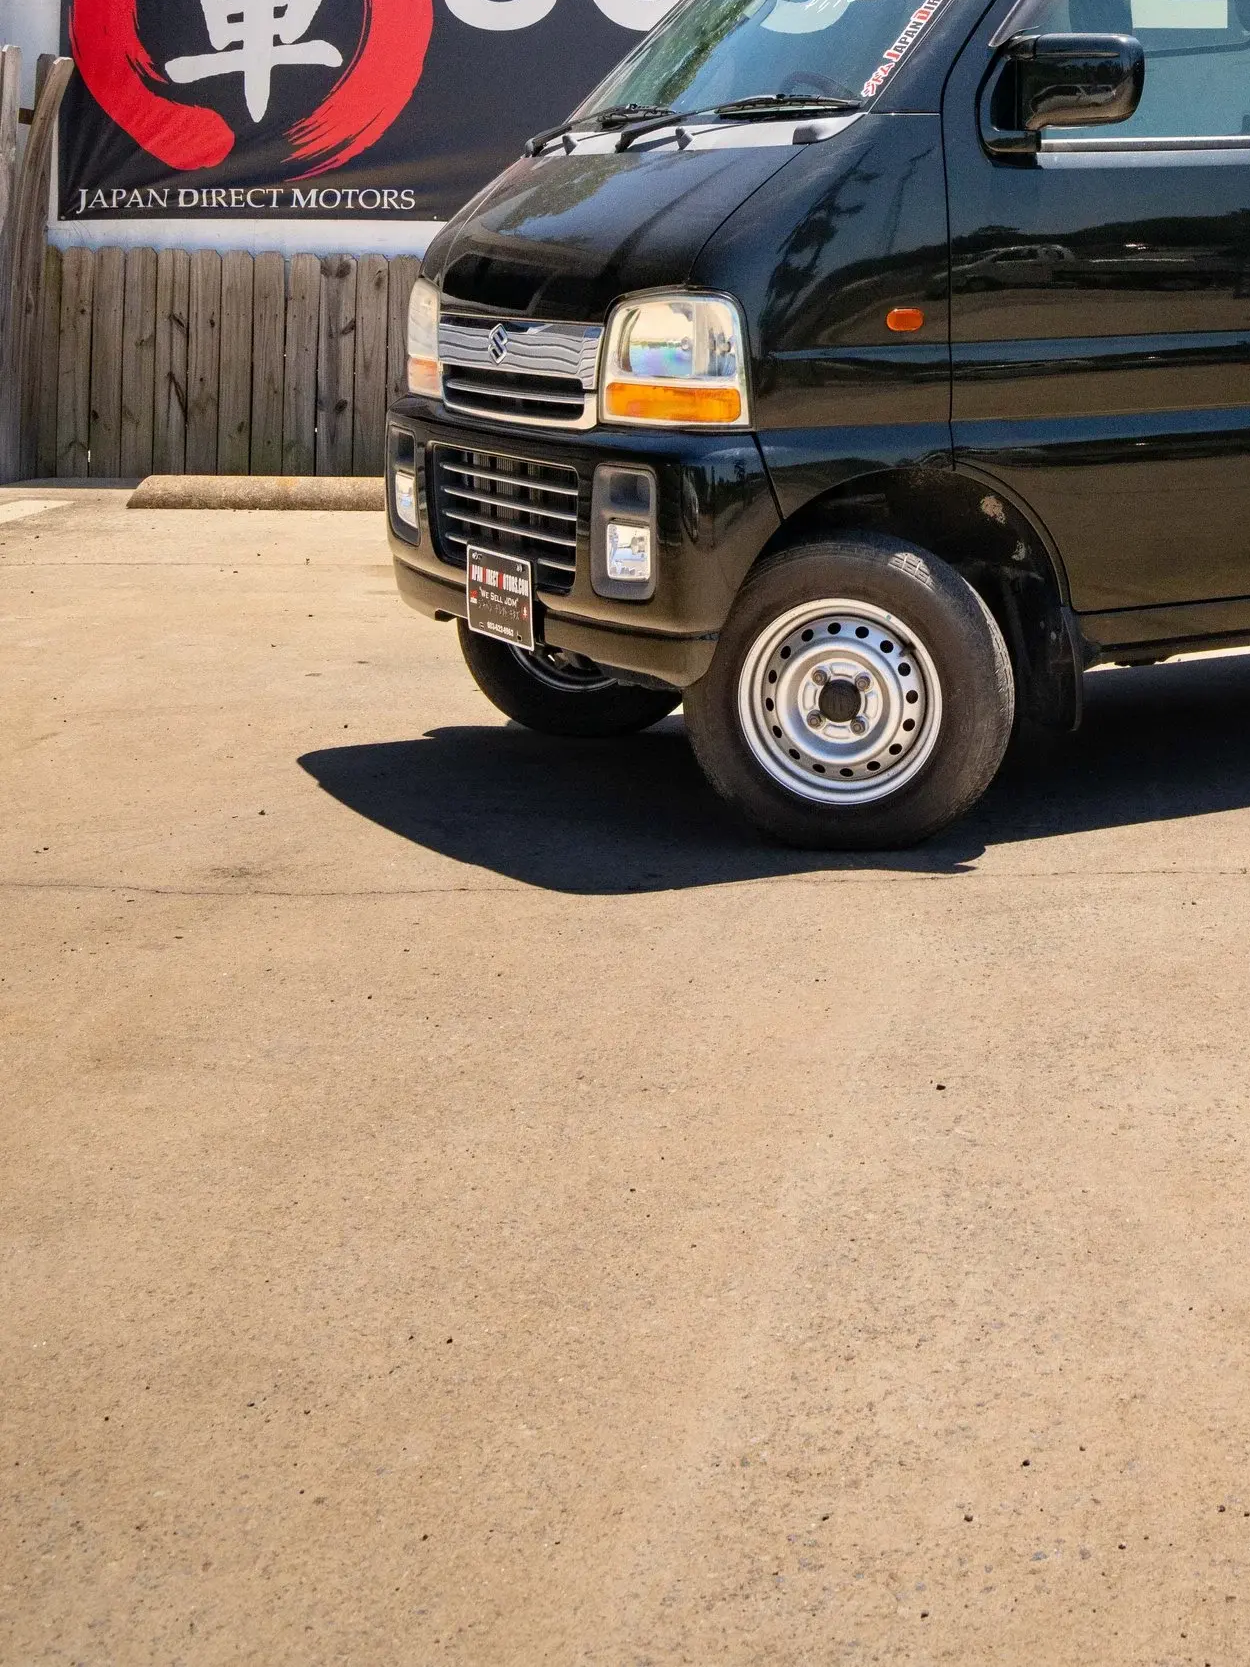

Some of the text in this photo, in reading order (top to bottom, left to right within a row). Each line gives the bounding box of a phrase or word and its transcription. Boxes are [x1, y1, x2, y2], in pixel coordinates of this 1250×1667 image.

[75, 188, 416, 215] JAPAN DIRECT MOTORS
